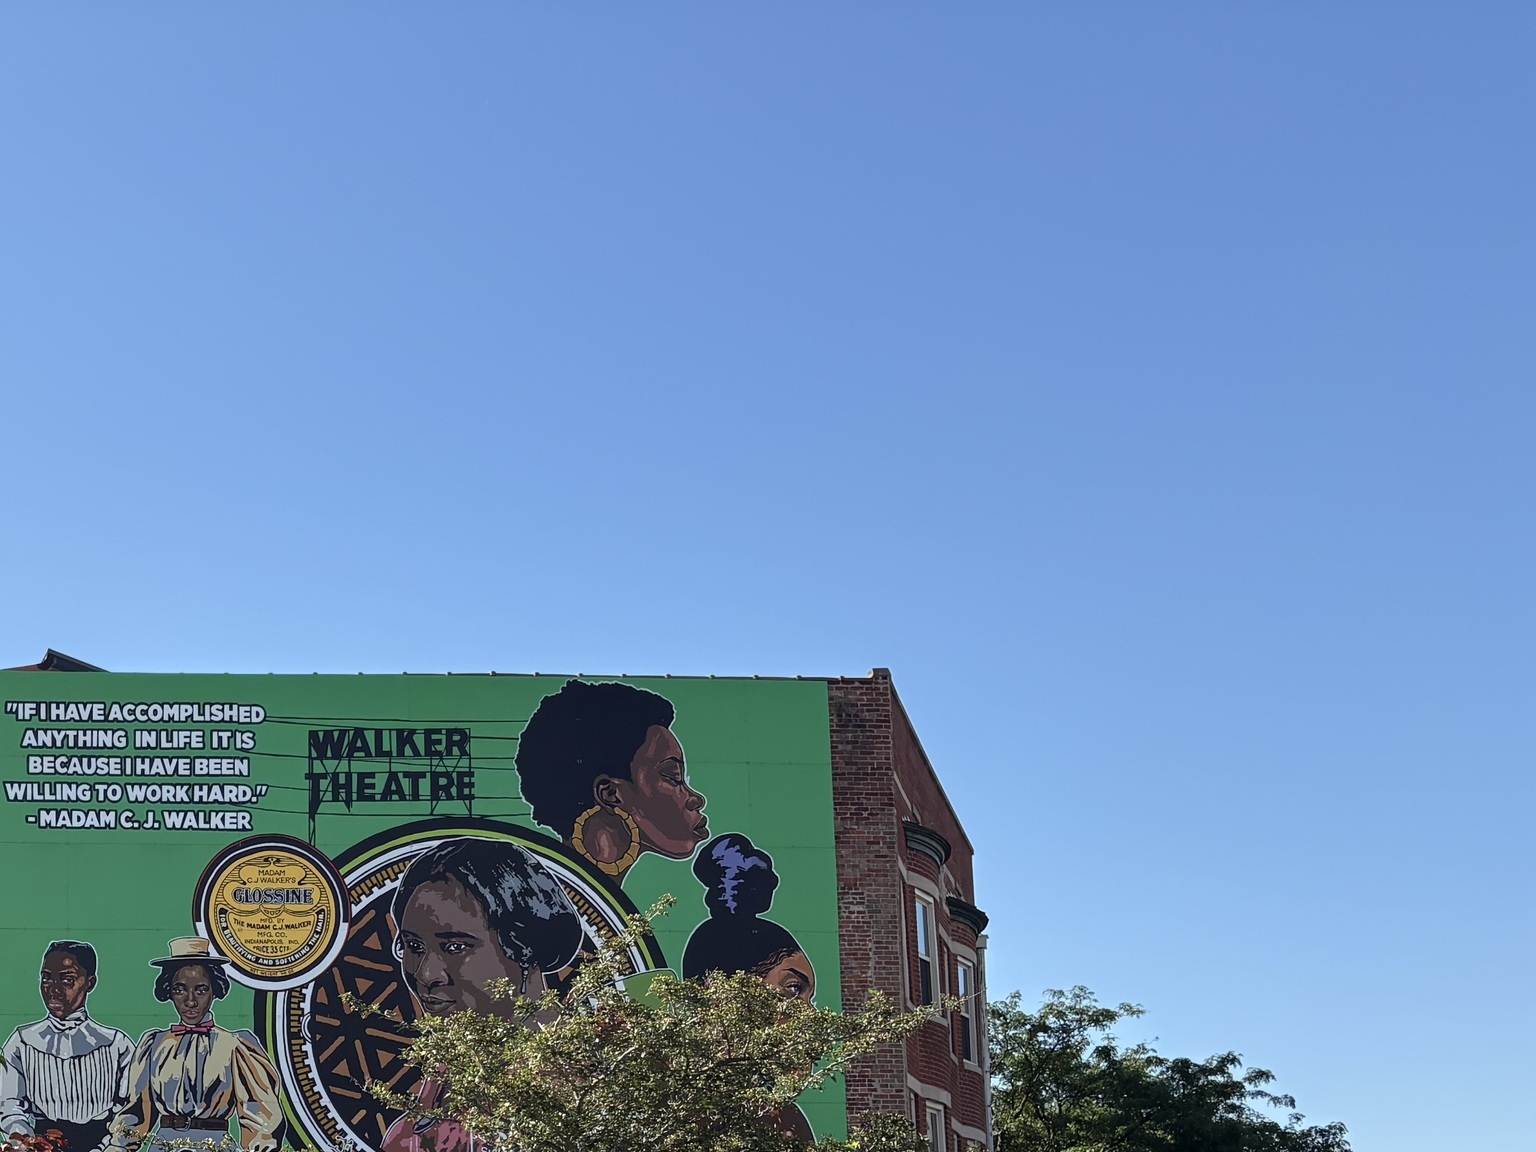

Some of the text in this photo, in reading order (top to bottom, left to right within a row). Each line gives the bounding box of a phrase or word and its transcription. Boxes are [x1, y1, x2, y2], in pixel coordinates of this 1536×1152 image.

[6, 702, 265, 723] "IF I HAVE ACCOMPLISHED
[21, 729, 255, 750] ANYTHING IN LIFE IT IS
[308, 728, 470, 760] WALKER
[27, 755, 249, 776] BECAUSE I HAVE BEEN
[4, 783, 268, 803] WILLING TO WORK HARD."
[304, 771, 475, 802] THEATRE
[39, 810, 116, 828] MADAM
[119, 811, 140, 829] C.
[142, 811, 160, 830] J.
[162, 811, 253, 830] WALKER
[258, 869, 286, 877] MADAM
[231, 887, 314, 905] GLOSSINE
[233, 918, 244, 927] THE
[246, 922, 271, 930] MADAM
[285, 920, 312, 930] WALKER
[219, 914, 227, 928] FOR
[224, 929, 256, 962] BEAUTIFYING
[275, 946, 310, 965] SOFTENING
[309, 933, 320, 946] THE
[270, 945, 278, 954] 35
